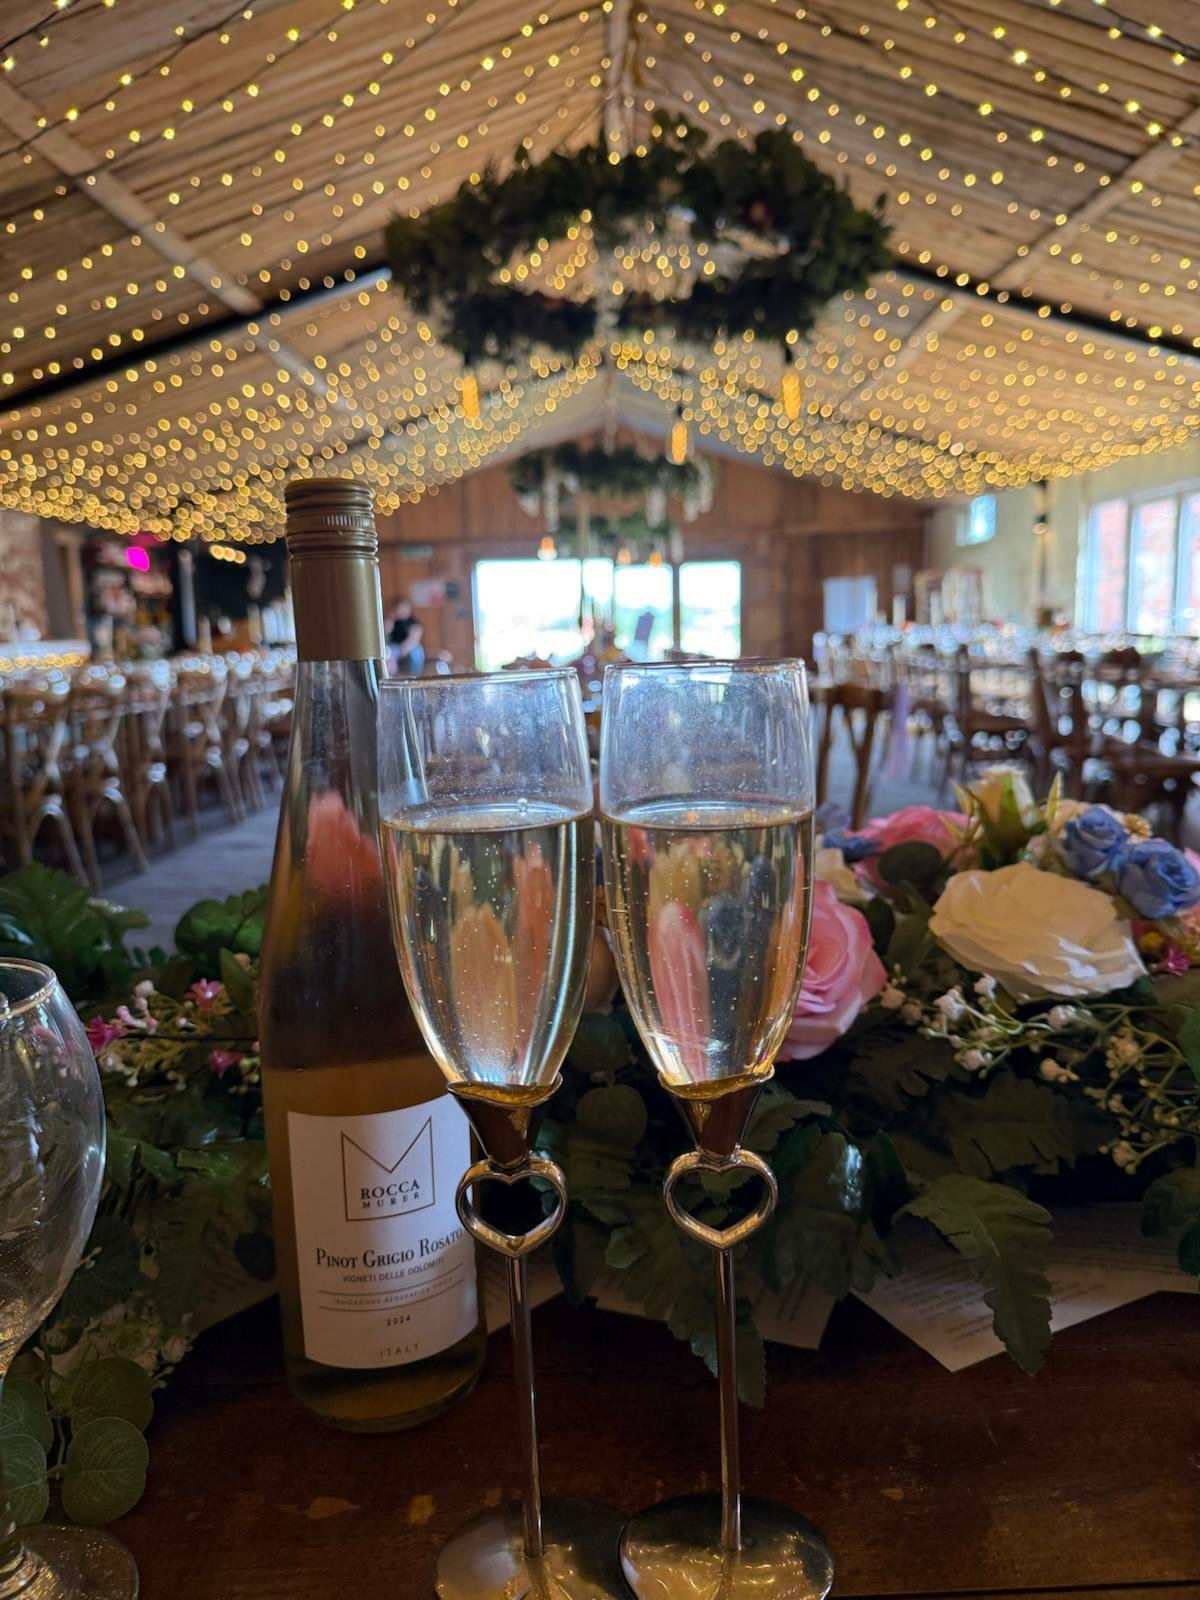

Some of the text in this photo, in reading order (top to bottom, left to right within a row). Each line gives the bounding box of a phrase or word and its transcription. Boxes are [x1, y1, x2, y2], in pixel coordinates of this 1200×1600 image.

[360, 1179, 420, 1200] ROCCA
[362, 1191, 420, 1208] MURER
[316, 1227, 463, 1268] PINOT GRIGIO ROSATO
[342, 1257, 445, 1283] VIGNETI DELLE DOLOMITI
[386, 1313, 412, 1326] 2024
[380, 1341, 421, 1357] ITALY
